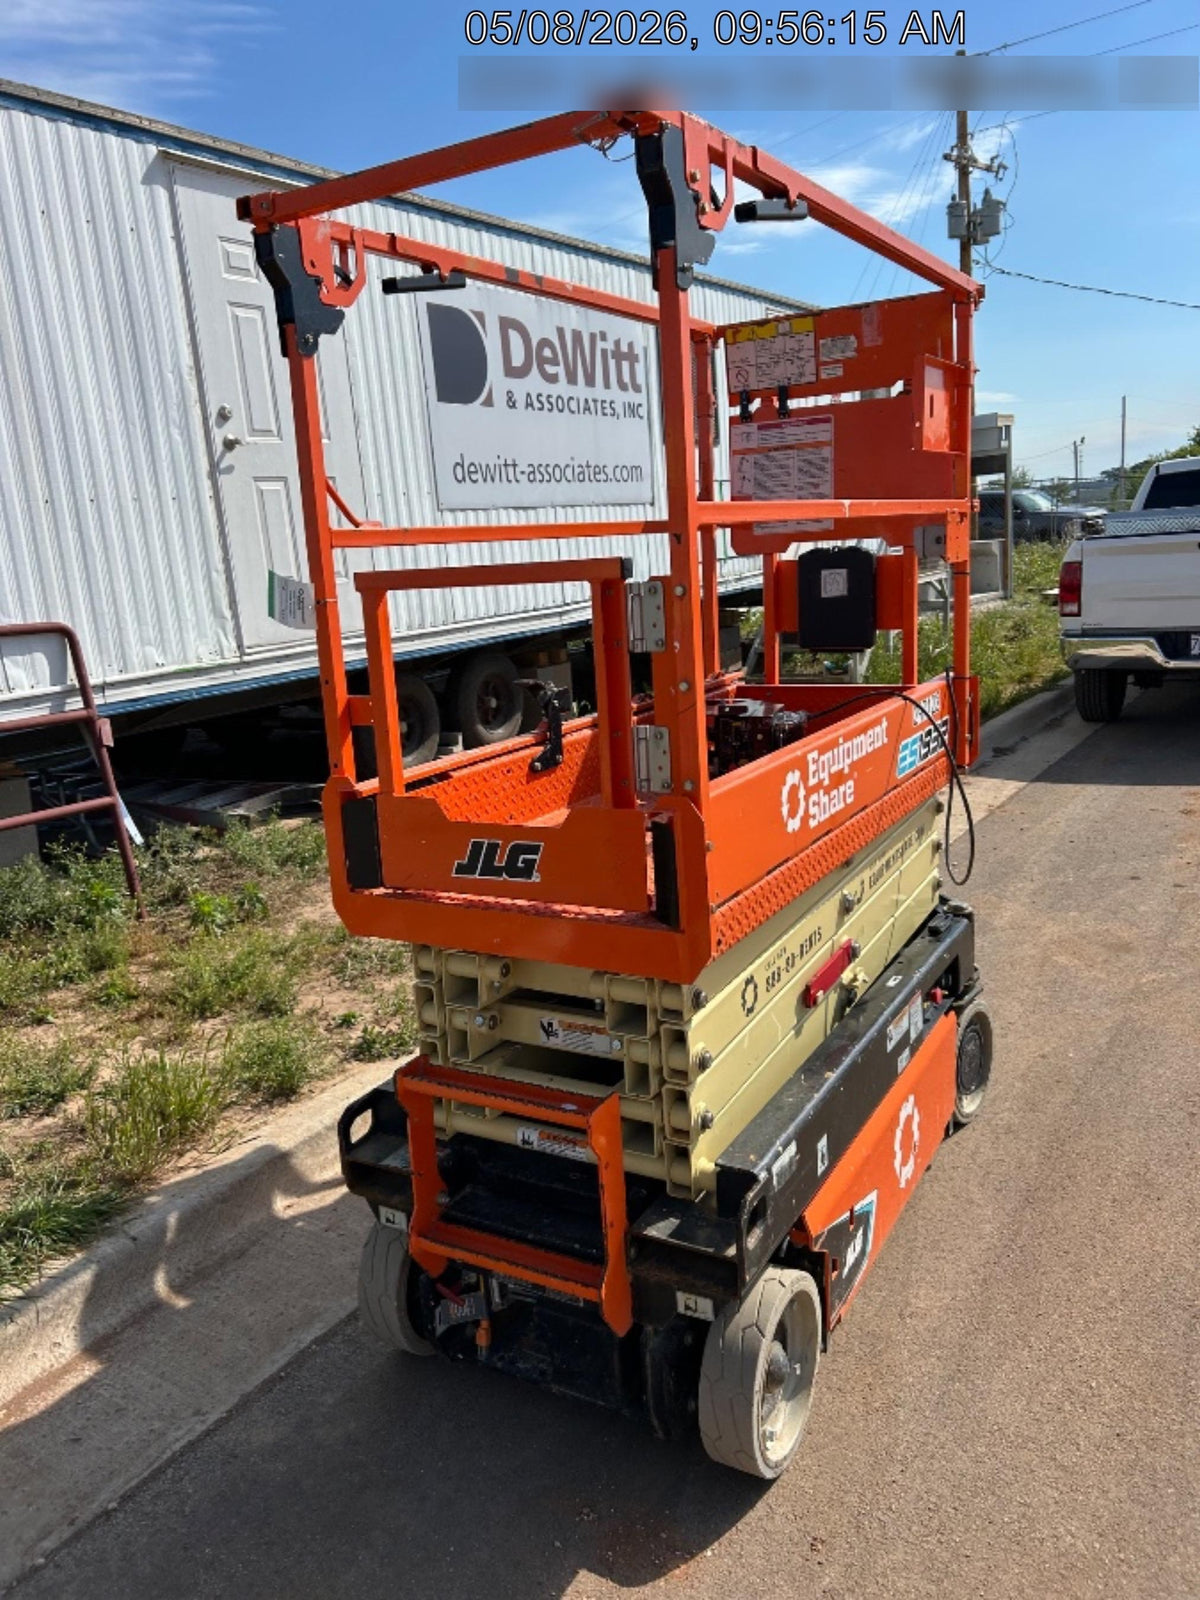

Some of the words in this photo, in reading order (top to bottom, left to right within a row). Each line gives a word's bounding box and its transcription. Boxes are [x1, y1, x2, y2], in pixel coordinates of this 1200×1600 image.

[498, 314, 643, 394] DeWitt
[506, 390, 517, 410] &
[524, 392, 620, 420] ASSOCIATES,
[623, 401, 644, 420] INC
[452, 453, 643, 484] dewitt-associates.com
[807, 717, 888, 787] Equipment
[808, 777, 855, 829] Share
[451, 838, 544, 882] JLG
